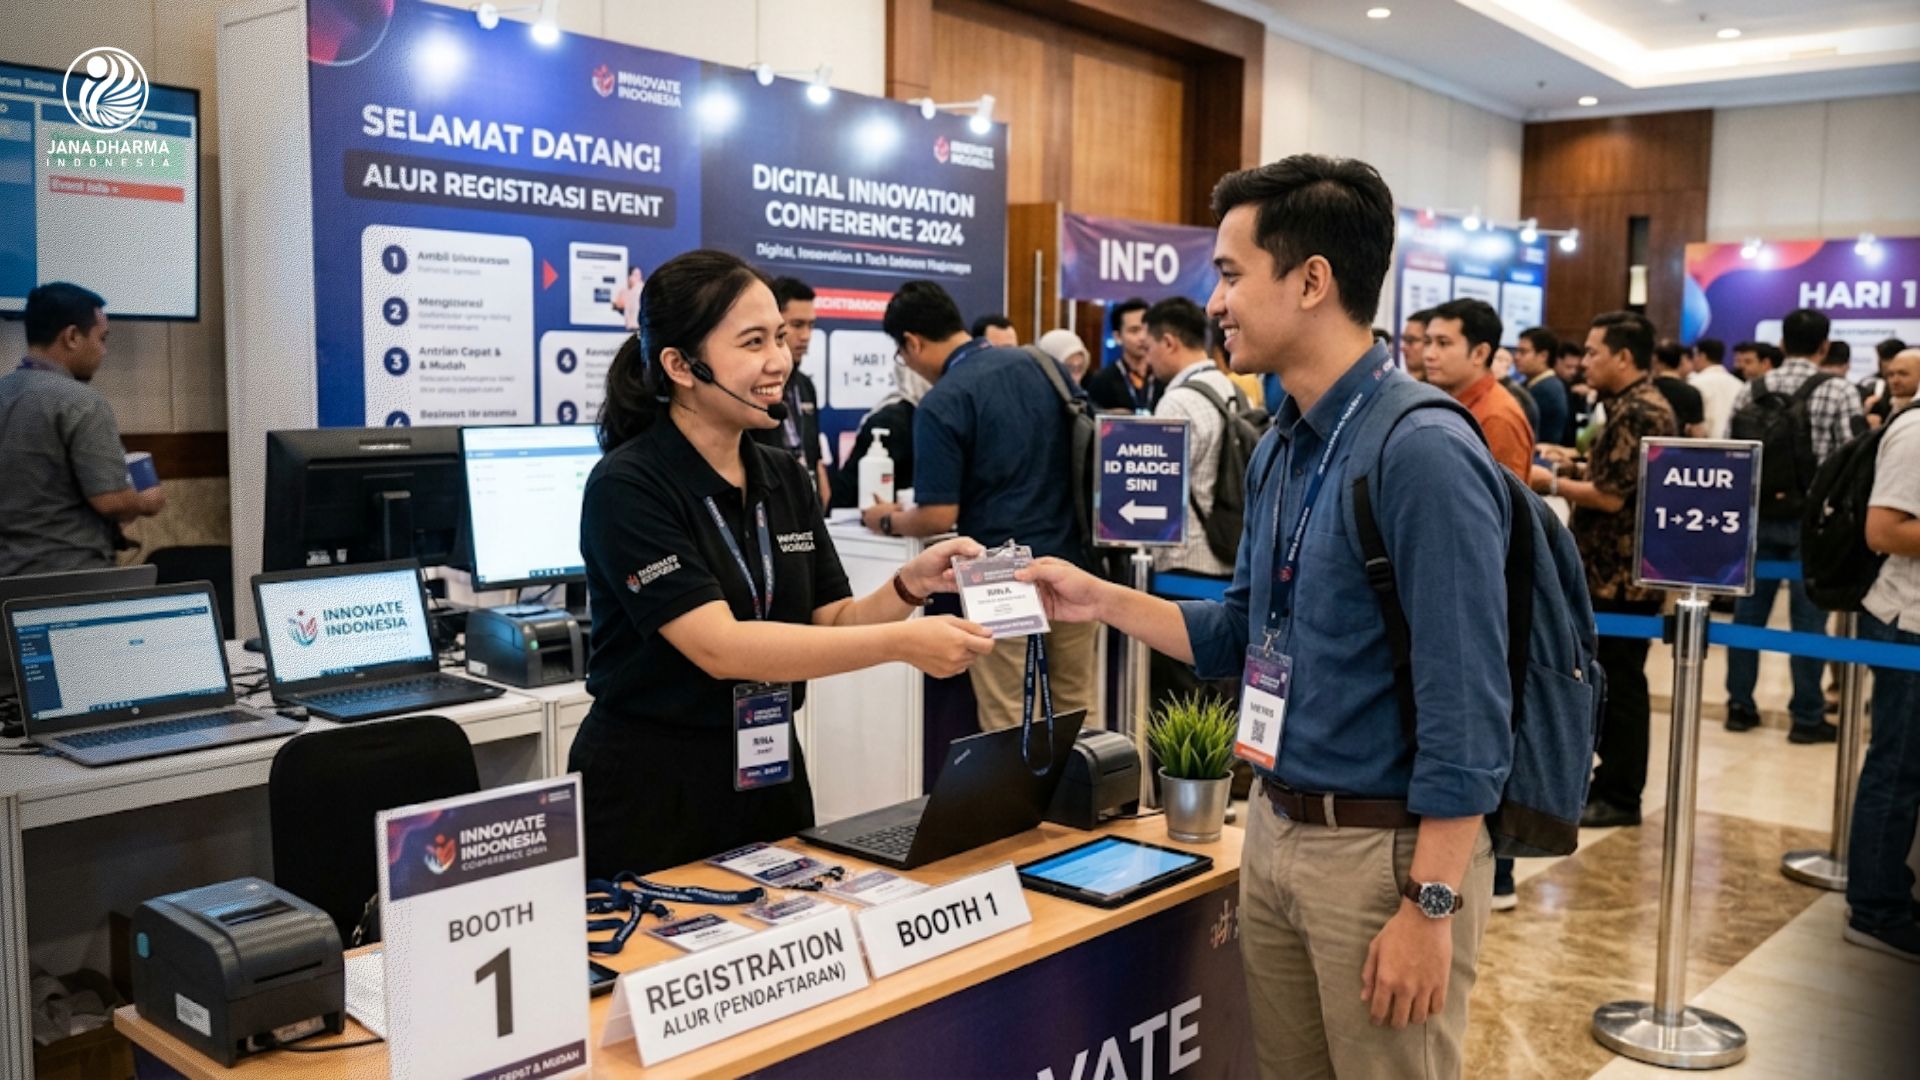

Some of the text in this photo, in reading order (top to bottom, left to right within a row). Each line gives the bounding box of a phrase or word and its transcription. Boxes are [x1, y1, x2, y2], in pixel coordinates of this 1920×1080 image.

[362, 104, 661, 173] SELAMAT DATANG!
[362, 163, 663, 218] ALUR REGISTRASI EVENT
[753, 163, 975, 218] DIGITAL INNOVATION
[765, 200, 964, 246] CONFERENCE 2024
[390, 252, 399, 268] 1
[1100, 238, 1180, 285] INFO
[1798, 280, 1917, 310] HARI 1
[389, 303, 402, 320] 2
[391, 354, 403, 370] 3
[562, 355, 572, 368] 4
[864, 374, 873, 387] 2
[562, 406, 572, 422] 5
[1116, 443, 1168, 458] AMBIL
[1104, 460, 1180, 475] ID BADGE
[1663, 466, 1734, 489] ALUR
[1125, 478, 1158, 492] SINI
[1655, 507, 1740, 534] 1 2 3
[322, 601, 405, 621] INNOVATE
[325, 617, 407, 637] INDONESIA
[460, 813, 546, 845] INNOVATE
[460, 830, 547, 860] INDONESIA
[449, 901, 534, 942] BOOTH
[897, 891, 999, 948] BOOTH 1
[645, 927, 845, 1016] REGISTRATION
[475, 947, 514, 1038] 1
[663, 961, 847, 1040] ALUR (PENDAFTARAN)
